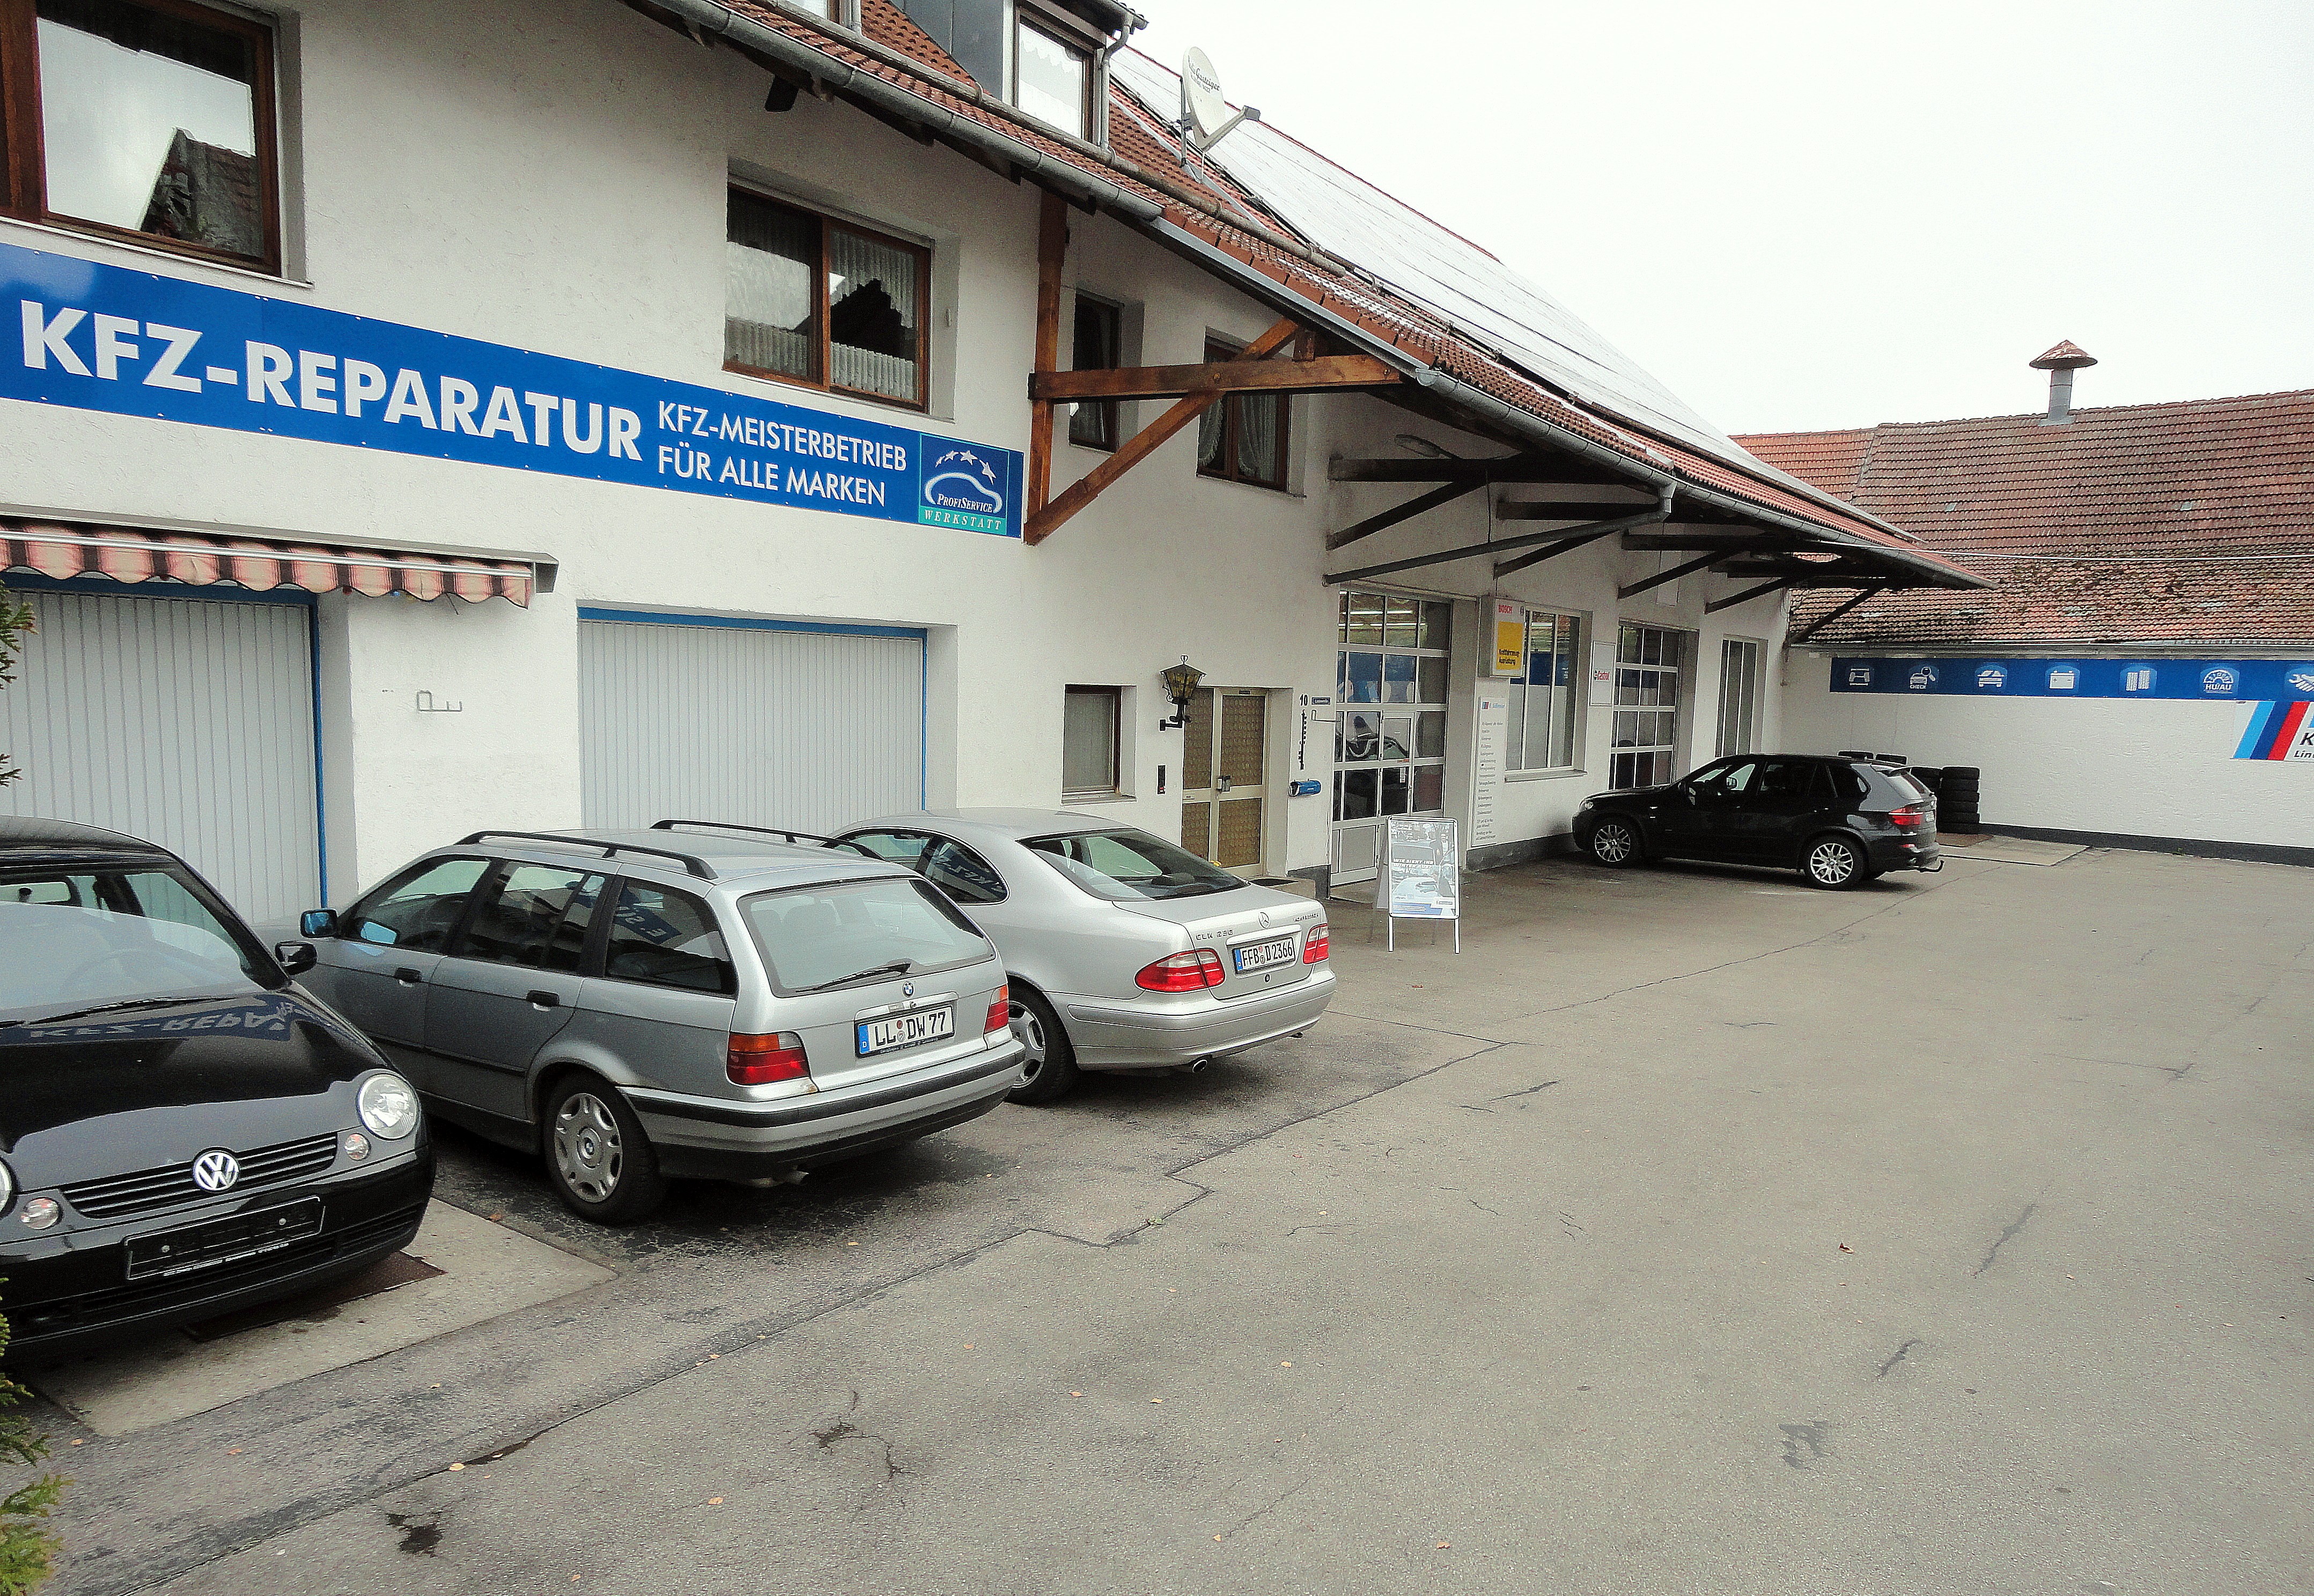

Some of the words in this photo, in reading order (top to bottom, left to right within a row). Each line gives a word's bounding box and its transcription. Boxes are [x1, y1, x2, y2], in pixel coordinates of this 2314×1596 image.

[20, 300, 643, 461] KFZ-REPARATUR
[658, 401, 907, 471] KFZ-MEISTERBETRIEB
[658, 442, 713, 482] FÜR
[719, 456, 779, 491] ALLE
[786, 467, 886, 507] MARKEN
[924, 509, 1001, 530] WERKSTATT
[1498, 604, 1513, 614] BOSCH
[1299, 694, 1308, 706] 10
[1196, 932, 1213, 941] CLK
[1242, 947, 1259, 966] FFB
[874, 1023, 896, 1046] LL
[906, 1015, 926, 1039] DW
[929, 1011, 946, 1034] 77
